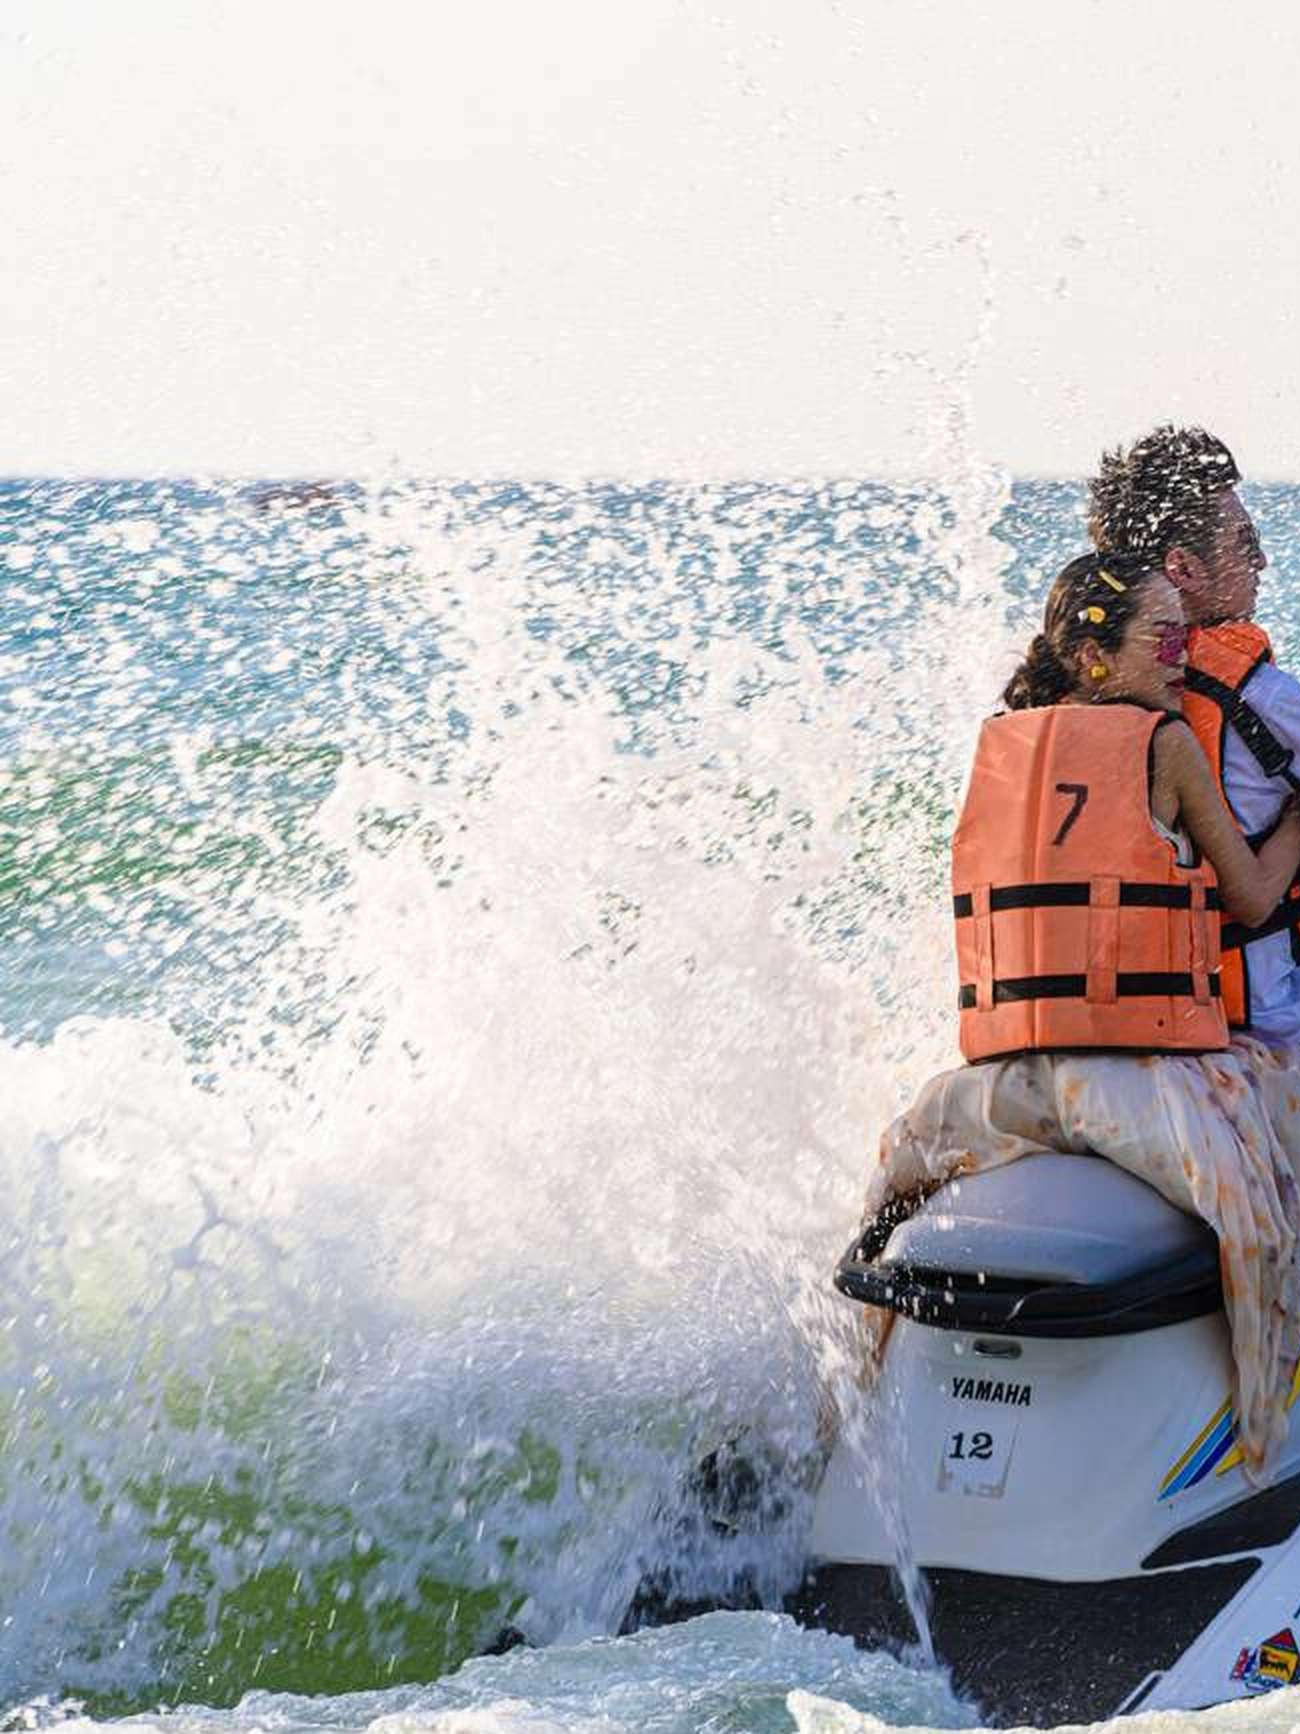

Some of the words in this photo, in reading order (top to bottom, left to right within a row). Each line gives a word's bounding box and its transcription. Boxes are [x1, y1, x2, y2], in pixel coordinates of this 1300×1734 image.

[1054, 782, 1089, 847] 7
[952, 1376, 1032, 1407] YAMAHA
[948, 1431, 993, 1460] 12
